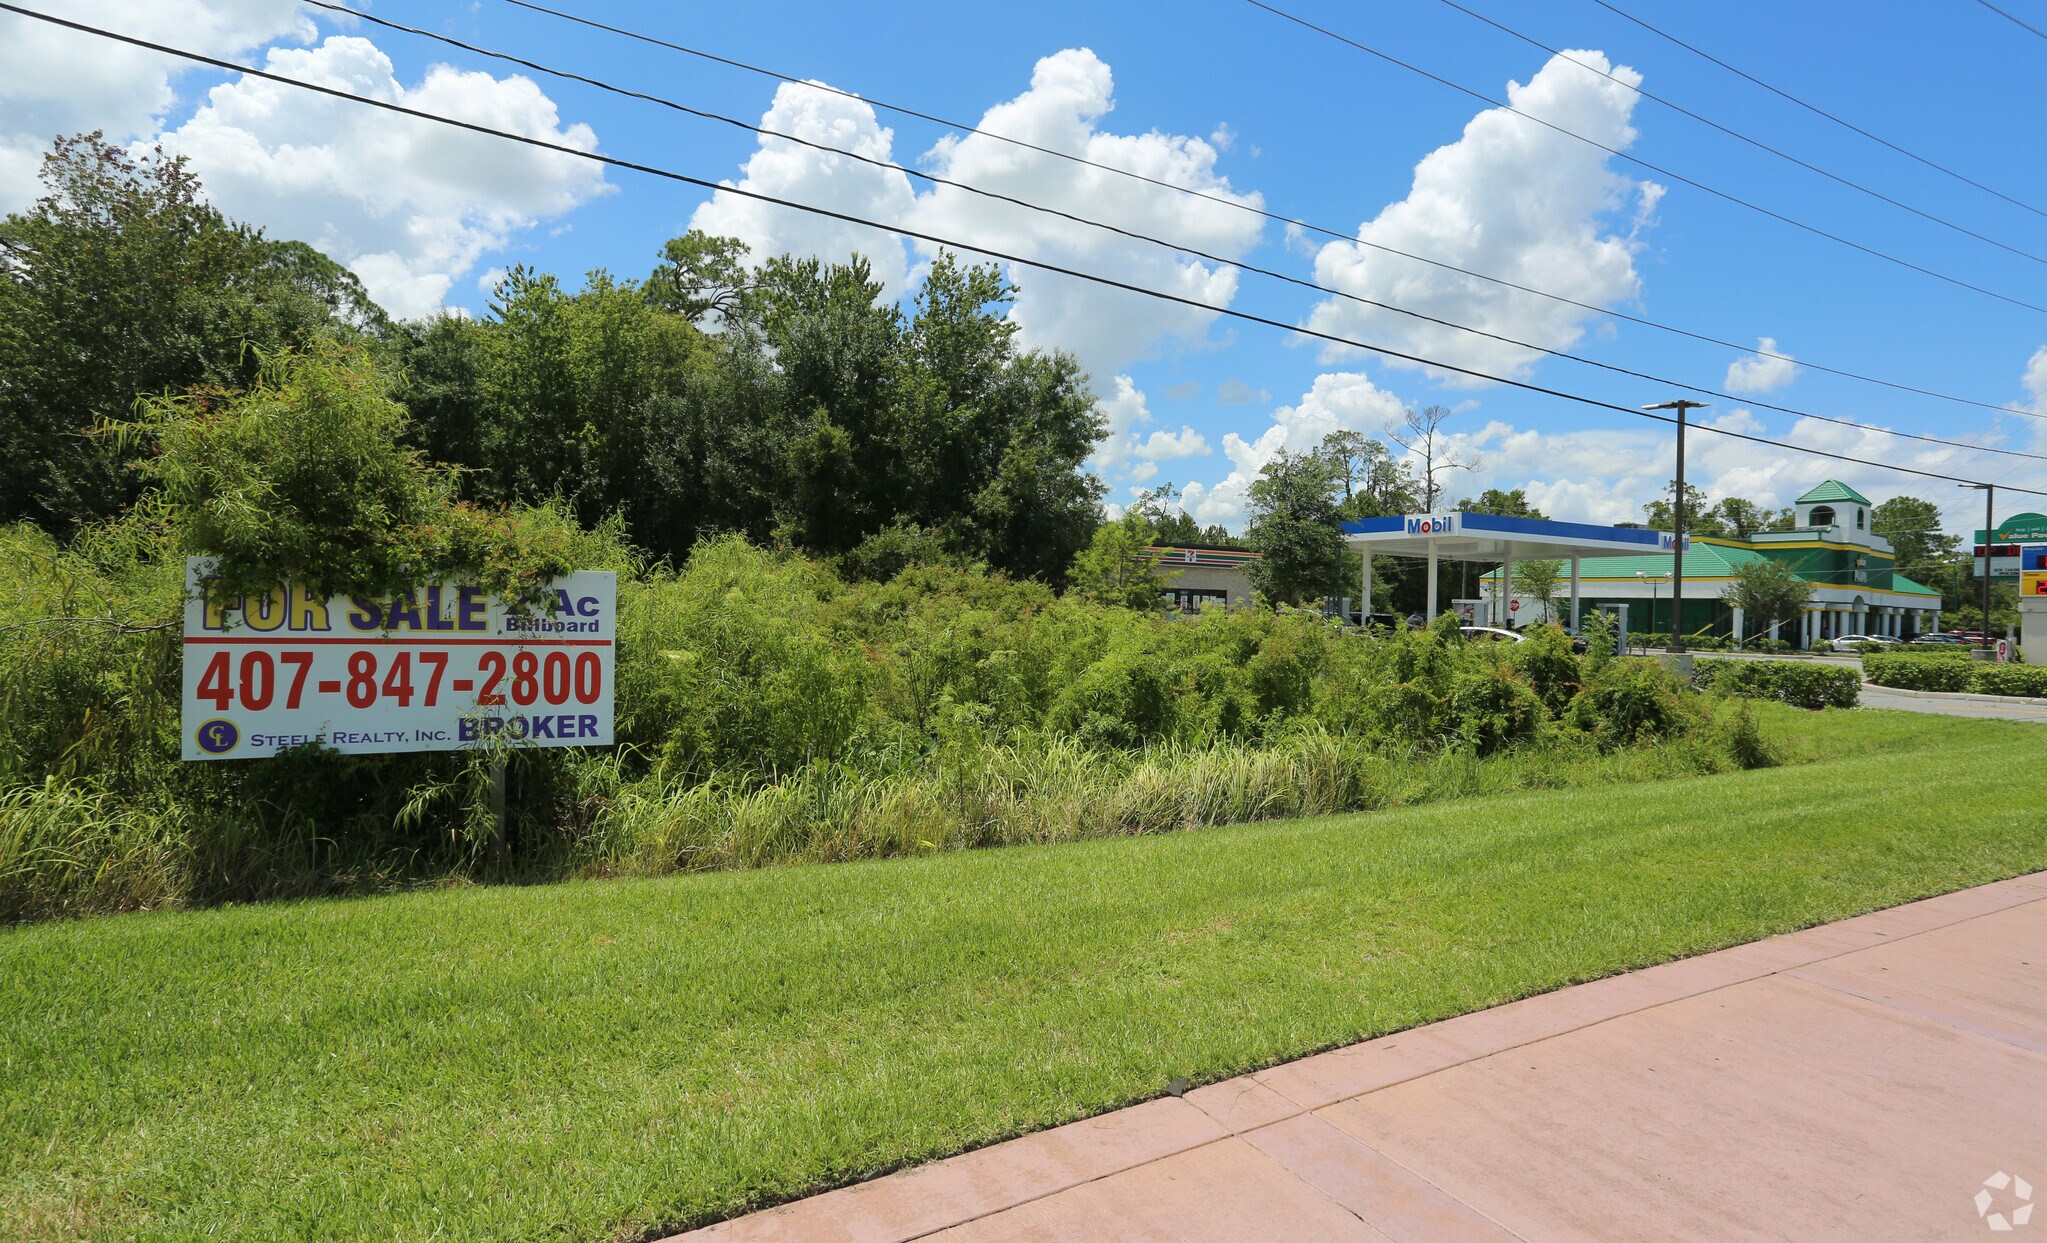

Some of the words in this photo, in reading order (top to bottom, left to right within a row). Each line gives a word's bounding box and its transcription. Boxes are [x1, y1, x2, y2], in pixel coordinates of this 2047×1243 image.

[1407, 516, 1452, 534] Mobil
[1663, 535, 1690, 551] Mil
[203, 576, 332, 632] FOR
[346, 580, 491, 634] SALE
[546, 588, 600, 617] Ac
[197, 650, 602, 711] 407-847-2800
[332, 731, 408, 744] REALTY,
[415, 729, 451, 742] INC.
[458, 715, 599, 742] BROKER
